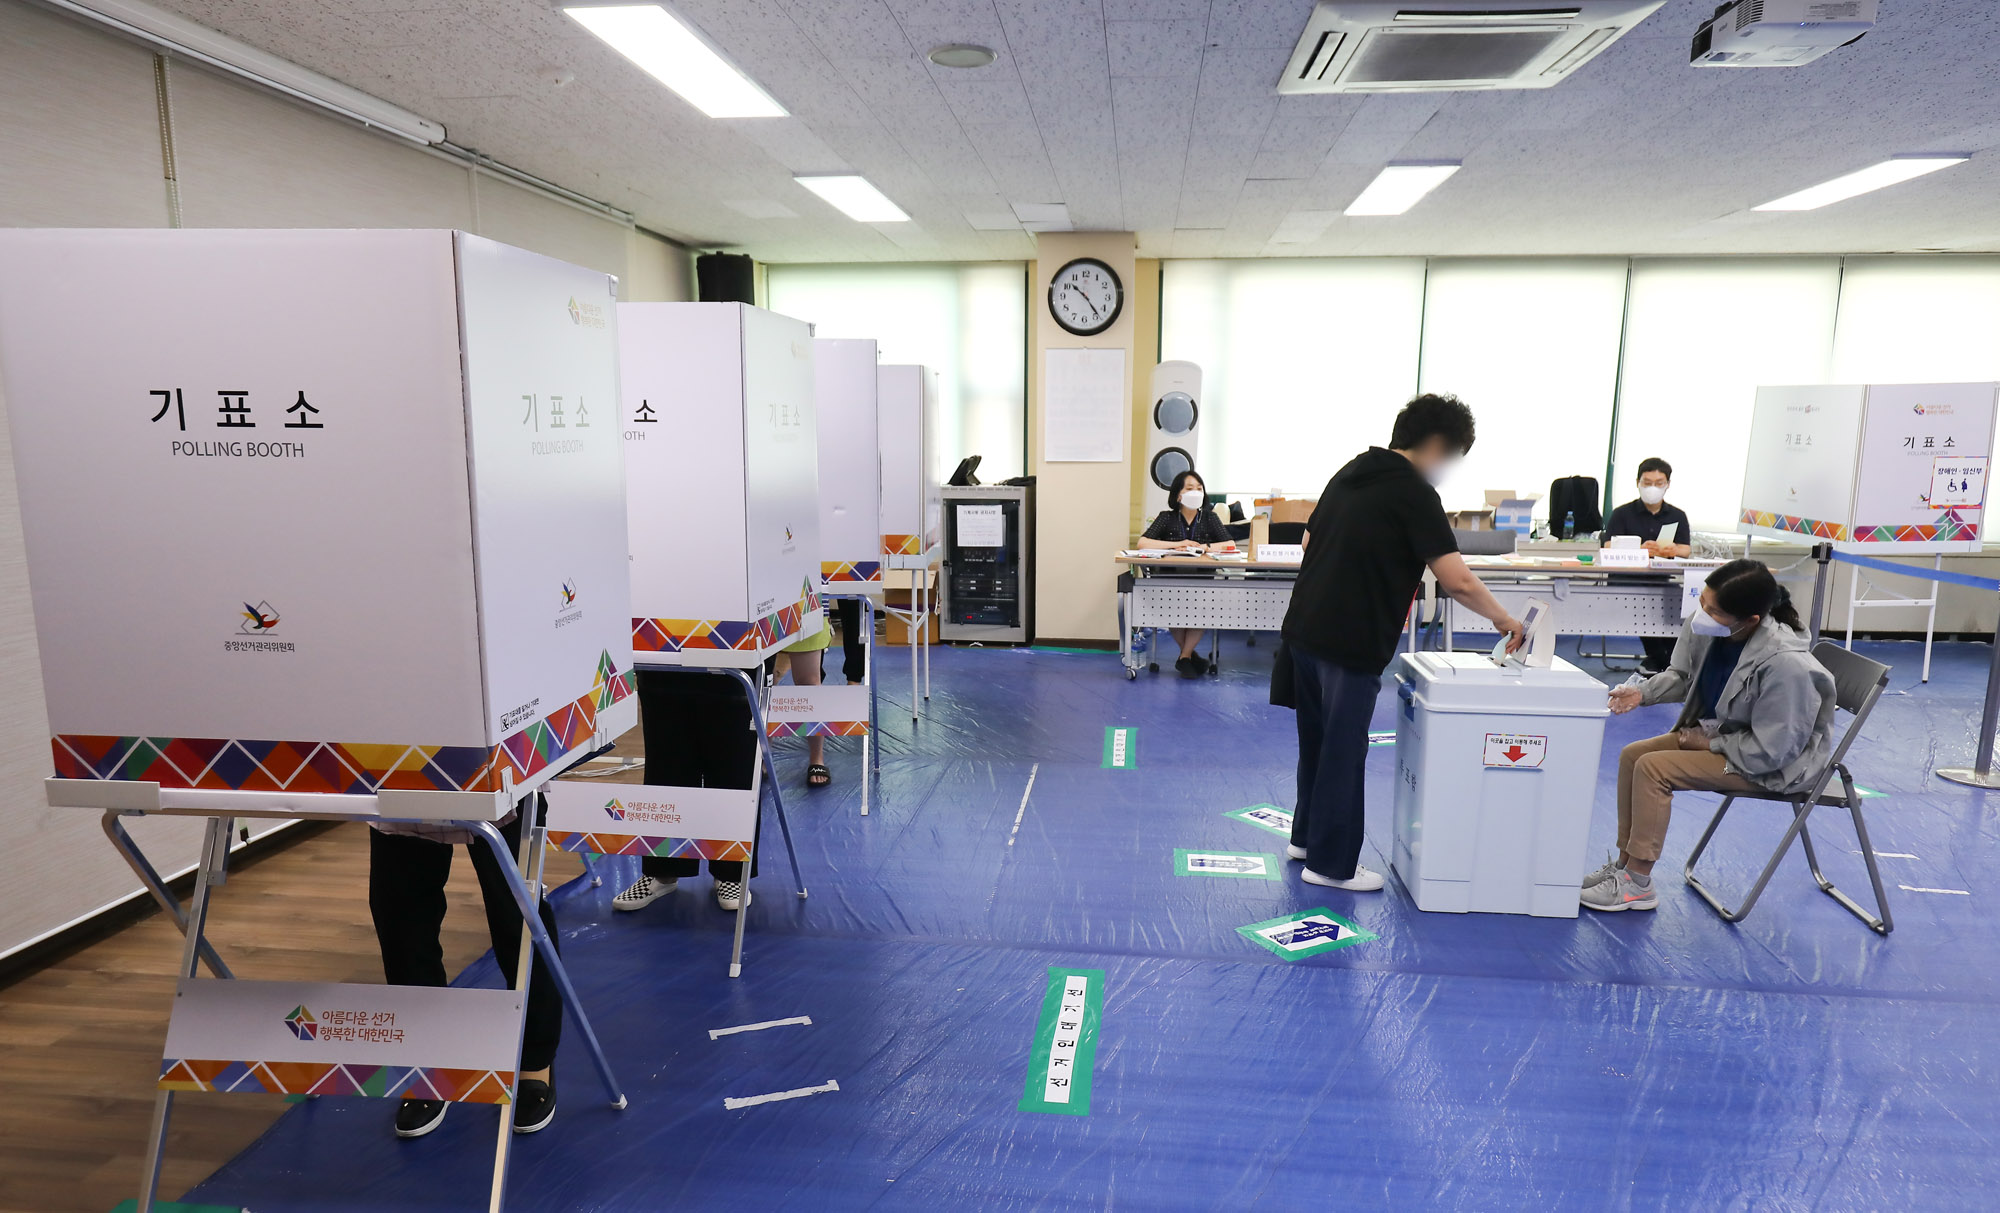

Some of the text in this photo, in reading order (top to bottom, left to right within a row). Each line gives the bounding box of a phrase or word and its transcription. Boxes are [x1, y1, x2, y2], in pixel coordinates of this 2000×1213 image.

[1082, 270, 1091, 278] 12
[1101, 281, 1108, 290] 2
[1060, 292, 1066, 300] 9
[1104, 294, 1111, 302] 3
[1101, 304, 1107, 312] 4
[1071, 313, 1077, 321] 7
[1081, 315, 1088, 324] 6
[1092, 312, 1099, 321] 5
[623, 431, 646, 441] OTH
[171, 441, 305, 458] POLLING BOOTH
[531, 440, 584, 455] POLLING BOOTH
[224, 641, 296, 653] 중앙선거관리위원회
[771, 697, 809, 705] 아름다운 선거
[627, 801, 676, 813] 아름다운 선거
[626, 812, 682, 825] 행복한 대한민국
[321, 1010, 396, 1027] 아름다운 선거
[319, 1026, 406, 1044] 행복한 대한민국
